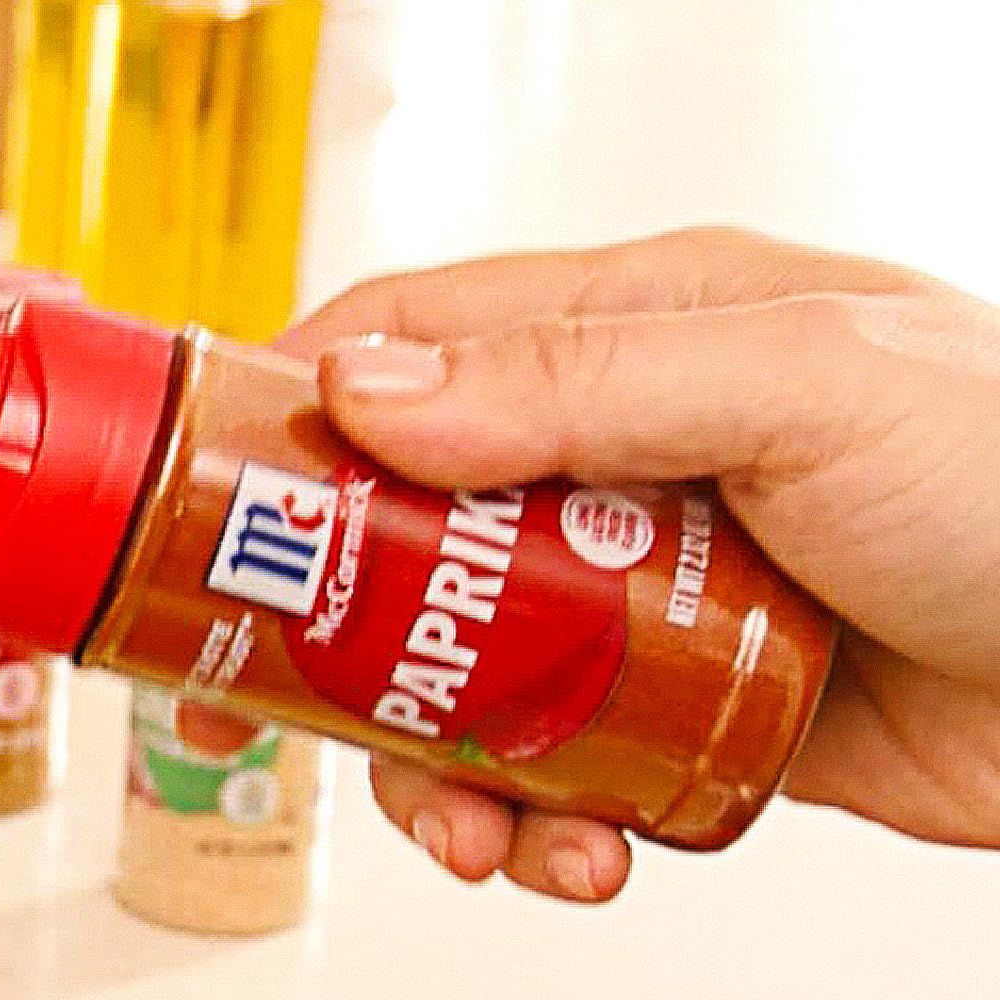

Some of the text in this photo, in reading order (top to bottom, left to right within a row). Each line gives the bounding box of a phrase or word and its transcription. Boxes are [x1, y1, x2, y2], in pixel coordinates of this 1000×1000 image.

[229, 492, 327, 585] Mc
[303, 476, 376, 644] McCormick
[372, 488, 524, 738] PAPRIK
